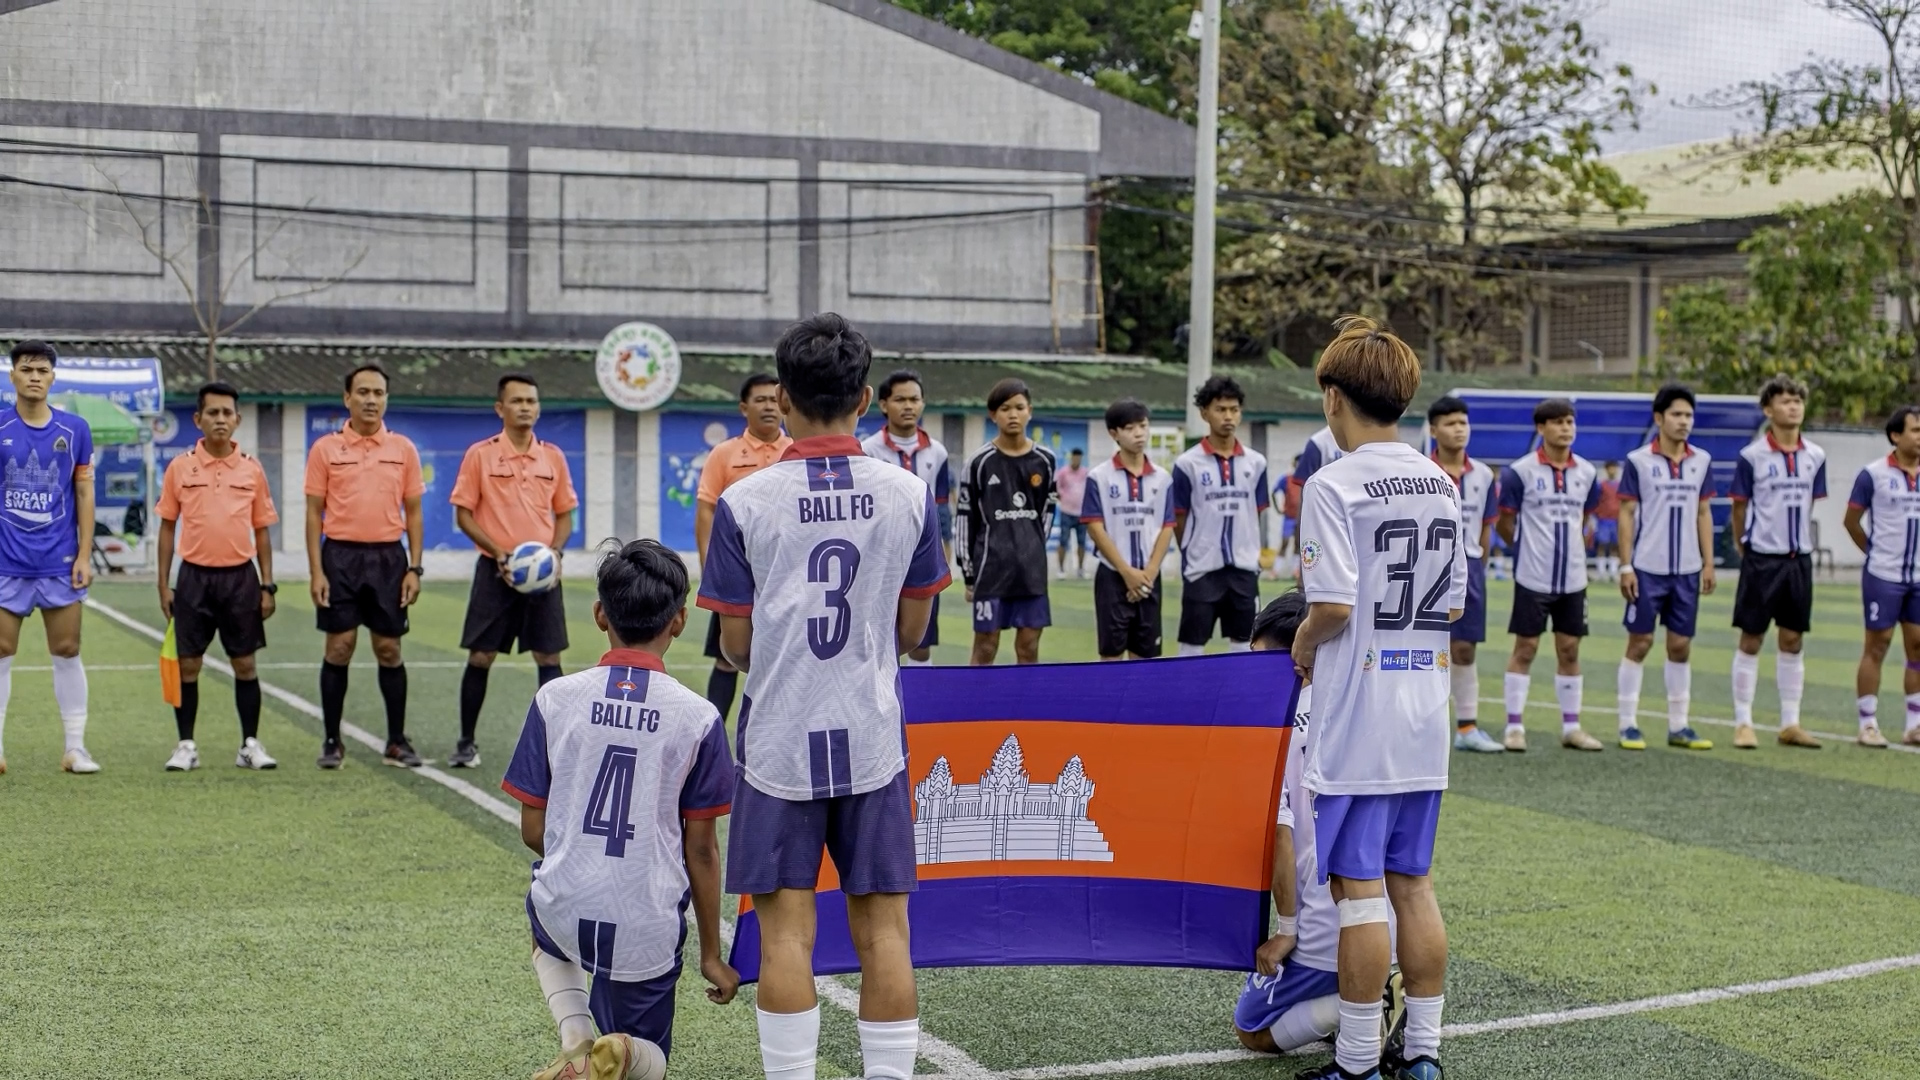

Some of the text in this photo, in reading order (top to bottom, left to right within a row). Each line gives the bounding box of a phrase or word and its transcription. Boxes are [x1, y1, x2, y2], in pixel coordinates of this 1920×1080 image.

[5, 490, 53, 503] POCARI
[5, 499, 49, 511] SWEAT
[798, 493, 874, 524] BALL FC
[1373, 518, 1457, 632] 32
[807, 538, 861, 661] 3
[976, 600, 993, 621] 24
[1869, 601, 1880, 621] 2
[591, 701, 661, 733] BALL FC
[582, 743, 638, 859] 4
